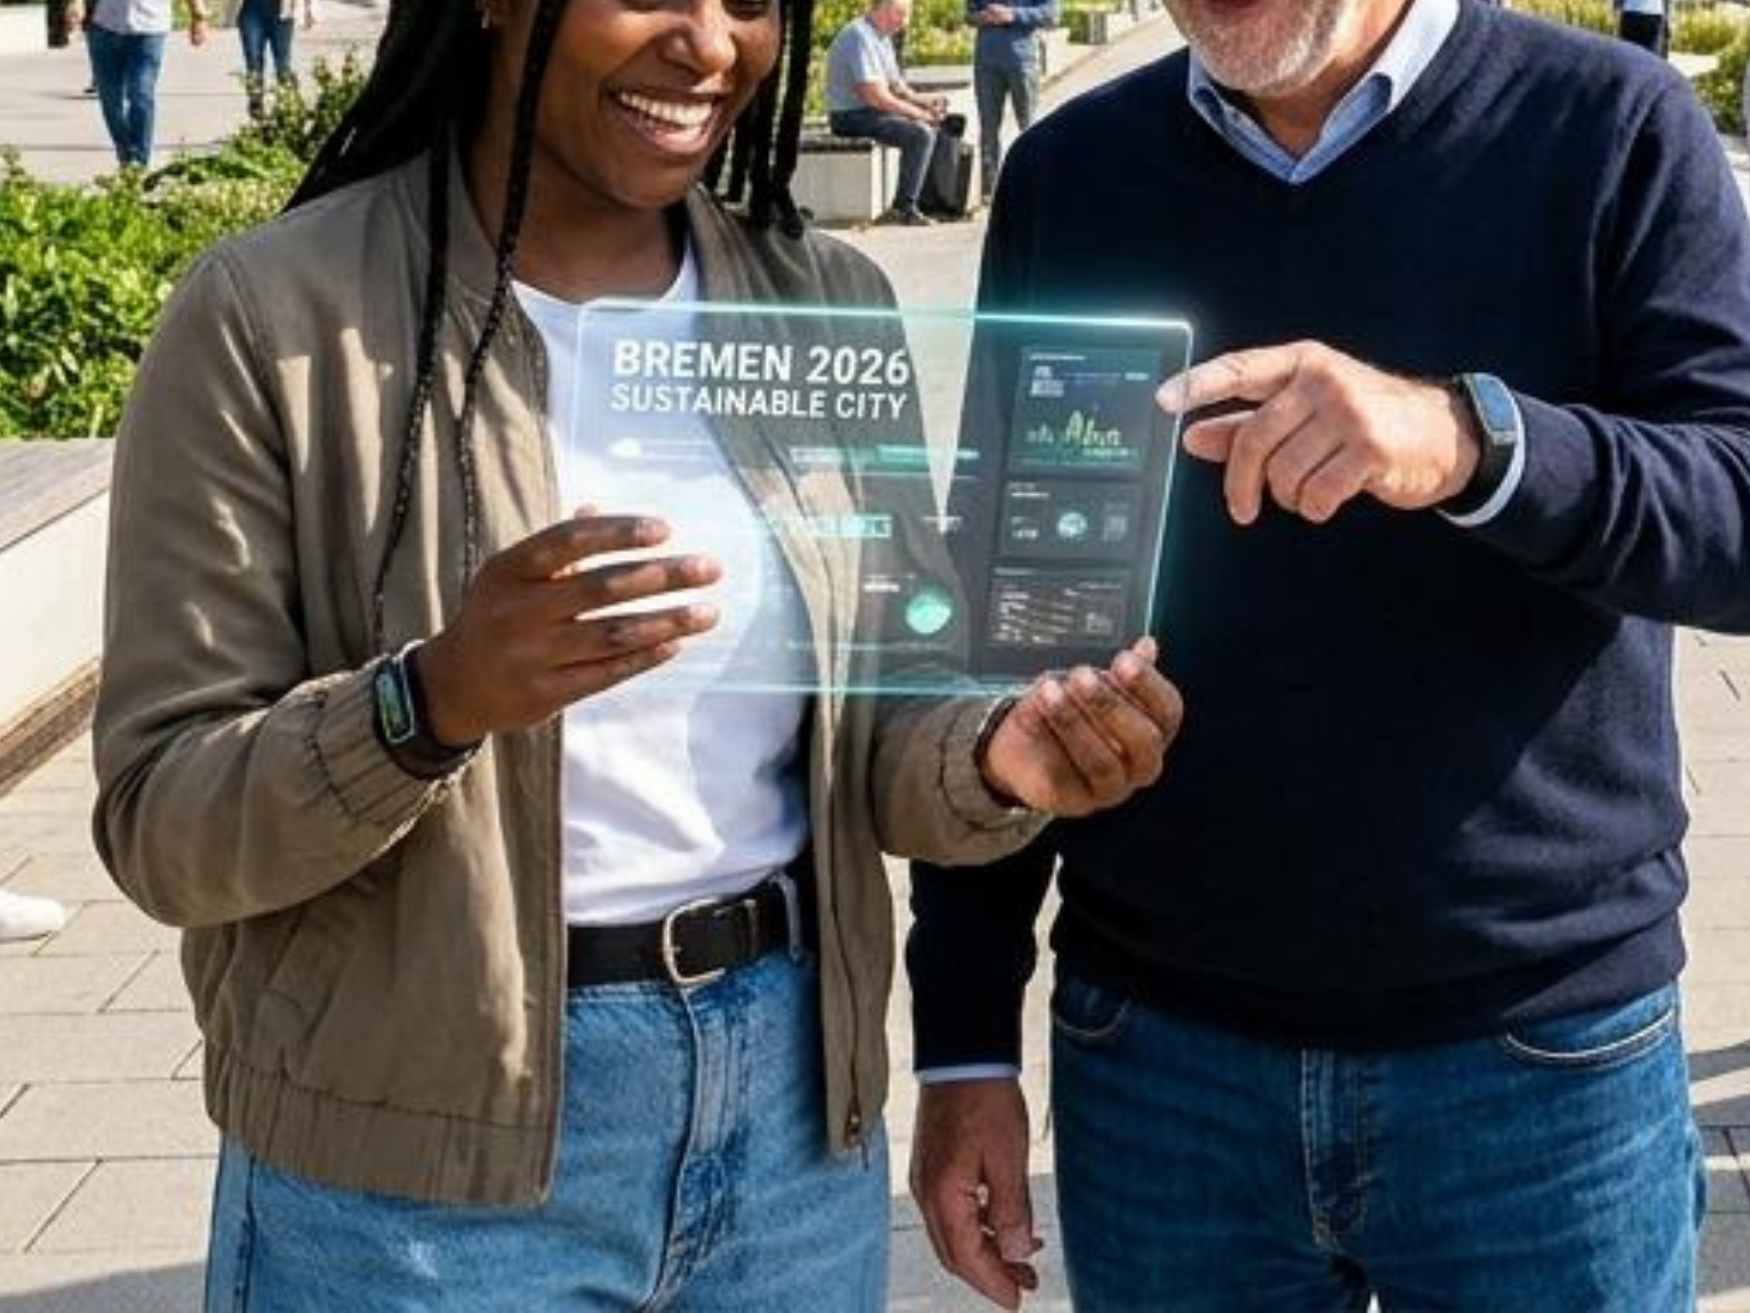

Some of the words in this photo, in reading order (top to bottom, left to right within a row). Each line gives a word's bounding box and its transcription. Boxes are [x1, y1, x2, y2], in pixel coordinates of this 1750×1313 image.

[613, 339, 793, 382] BREMEN
[807, 346, 909, 385] 2026
[611, 386, 826, 418] SUSTAINABLE
[835, 390, 908, 420] CITY
